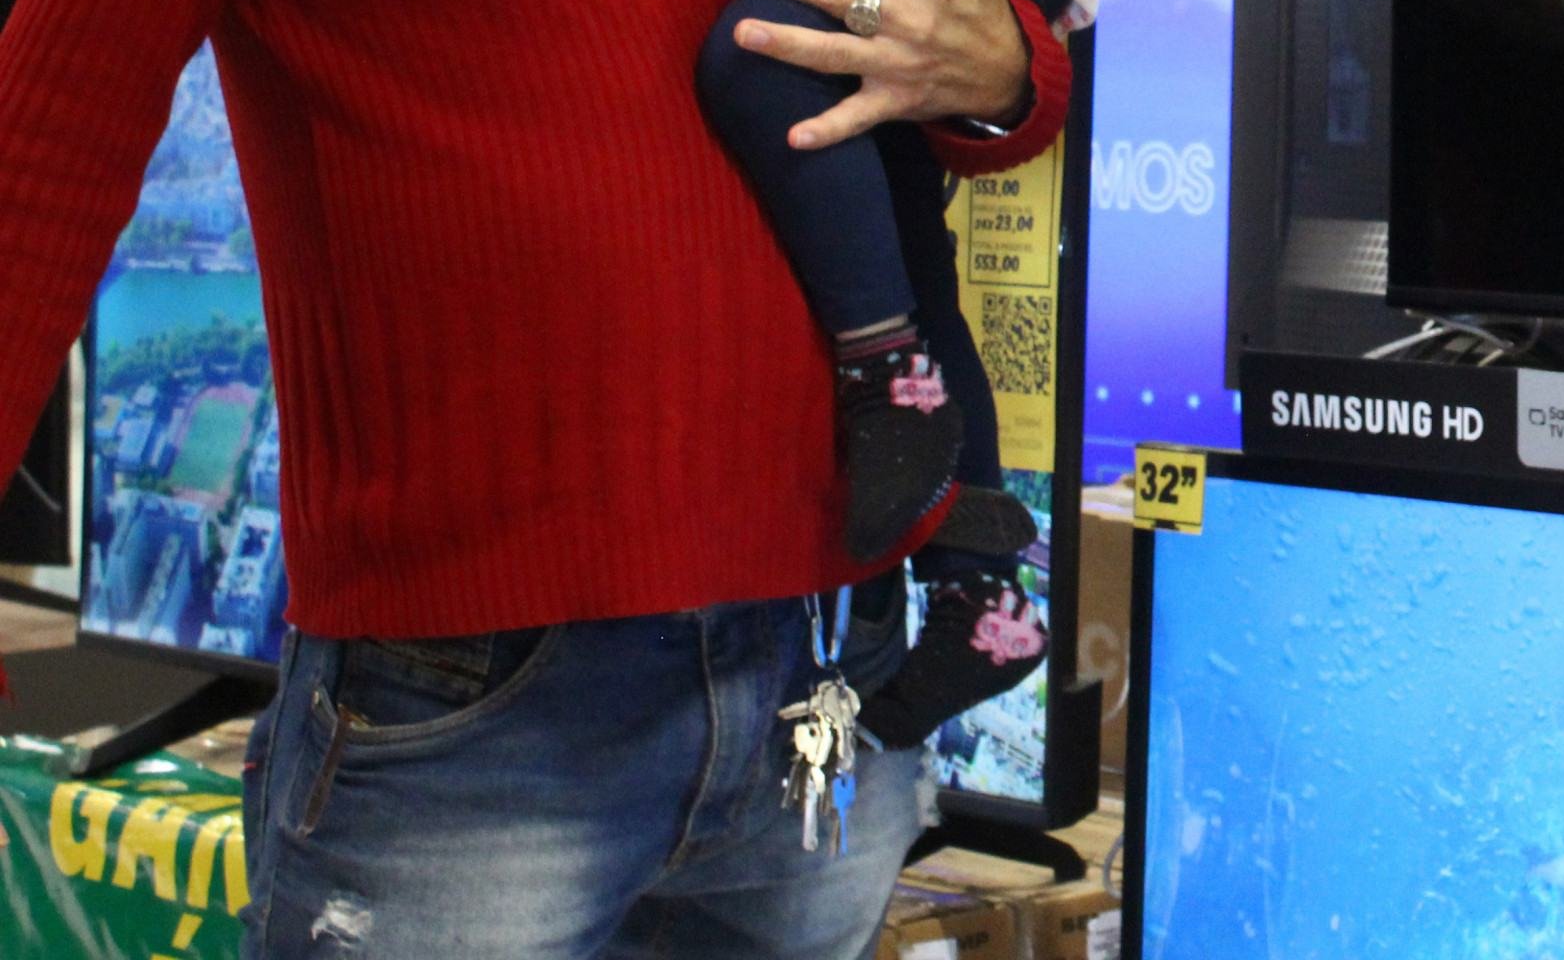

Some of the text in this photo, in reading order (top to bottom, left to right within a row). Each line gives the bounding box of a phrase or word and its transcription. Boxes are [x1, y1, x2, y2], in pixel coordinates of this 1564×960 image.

[1271, 389, 1485, 442] SAMSUNG HD
[1549, 424, 1564, 439] TV
